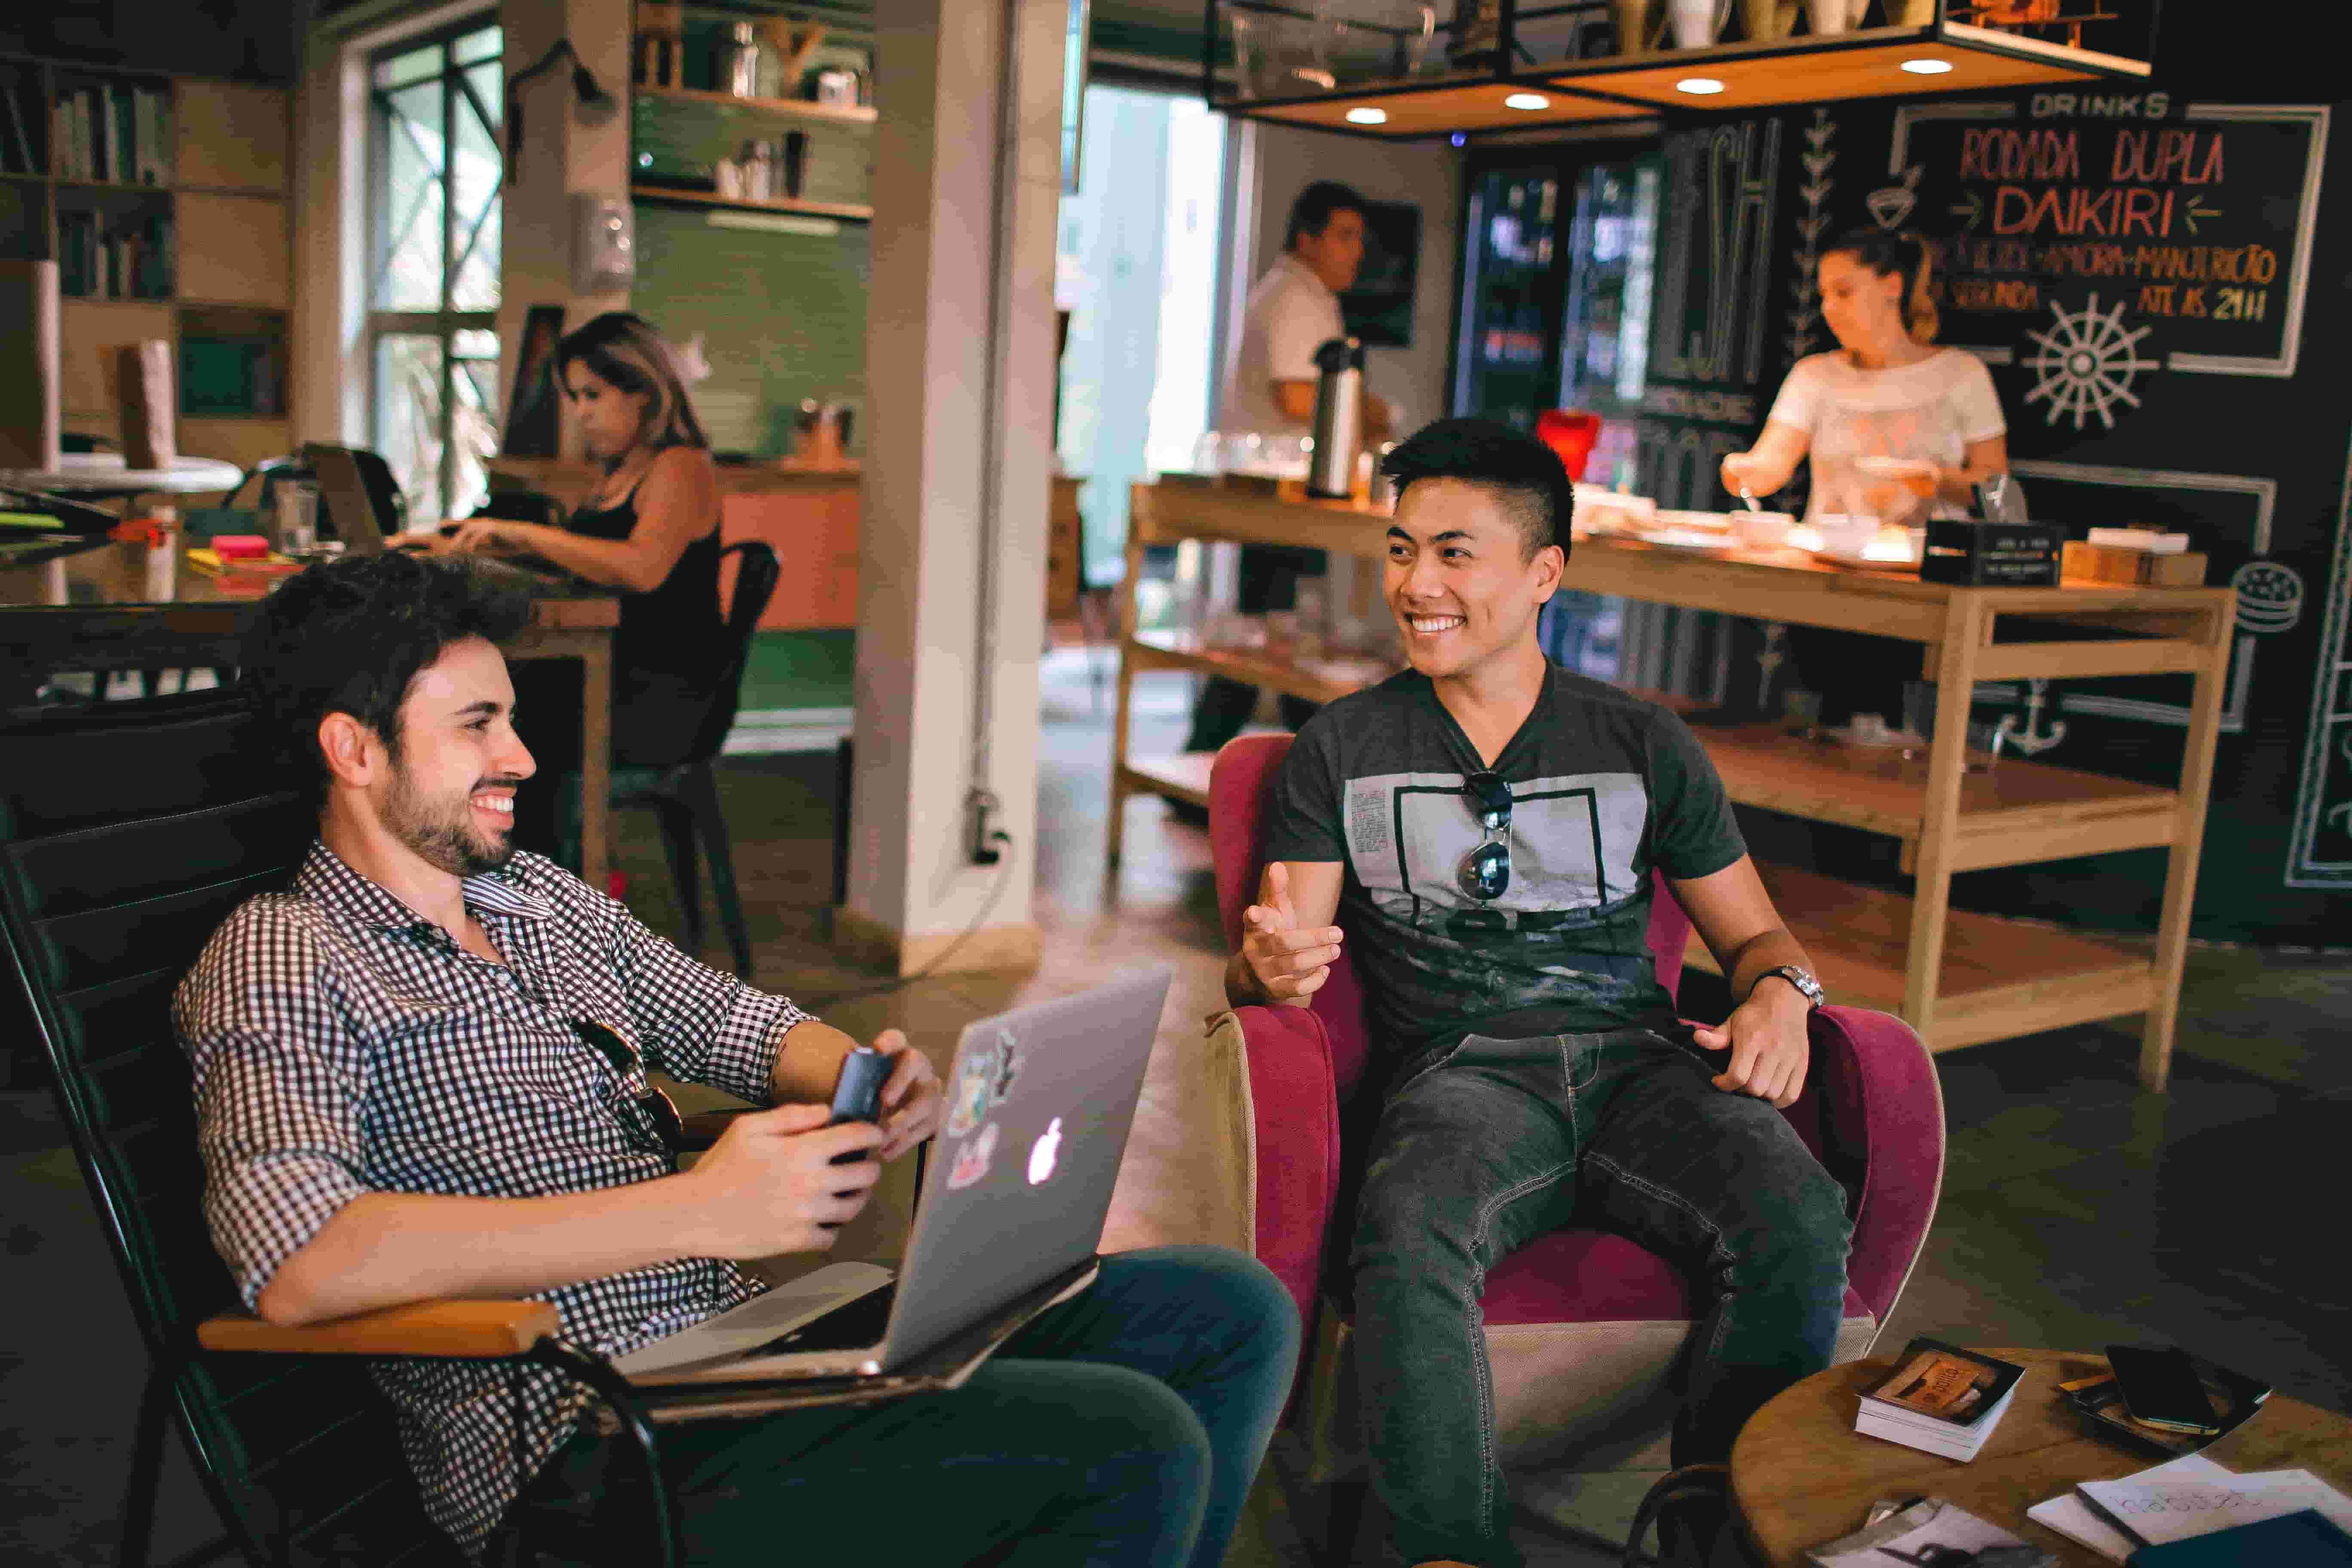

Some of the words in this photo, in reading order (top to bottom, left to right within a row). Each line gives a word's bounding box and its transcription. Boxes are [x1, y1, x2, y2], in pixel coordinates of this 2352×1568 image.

[2032, 94, 2169, 117] DRINKS
[1961, 129, 2079, 179] RODADA
[2112, 130, 2222, 184] DUPLA
[1994, 187, 2172, 237] DAIKIRI
[2213, 287, 2267, 321] 21H
